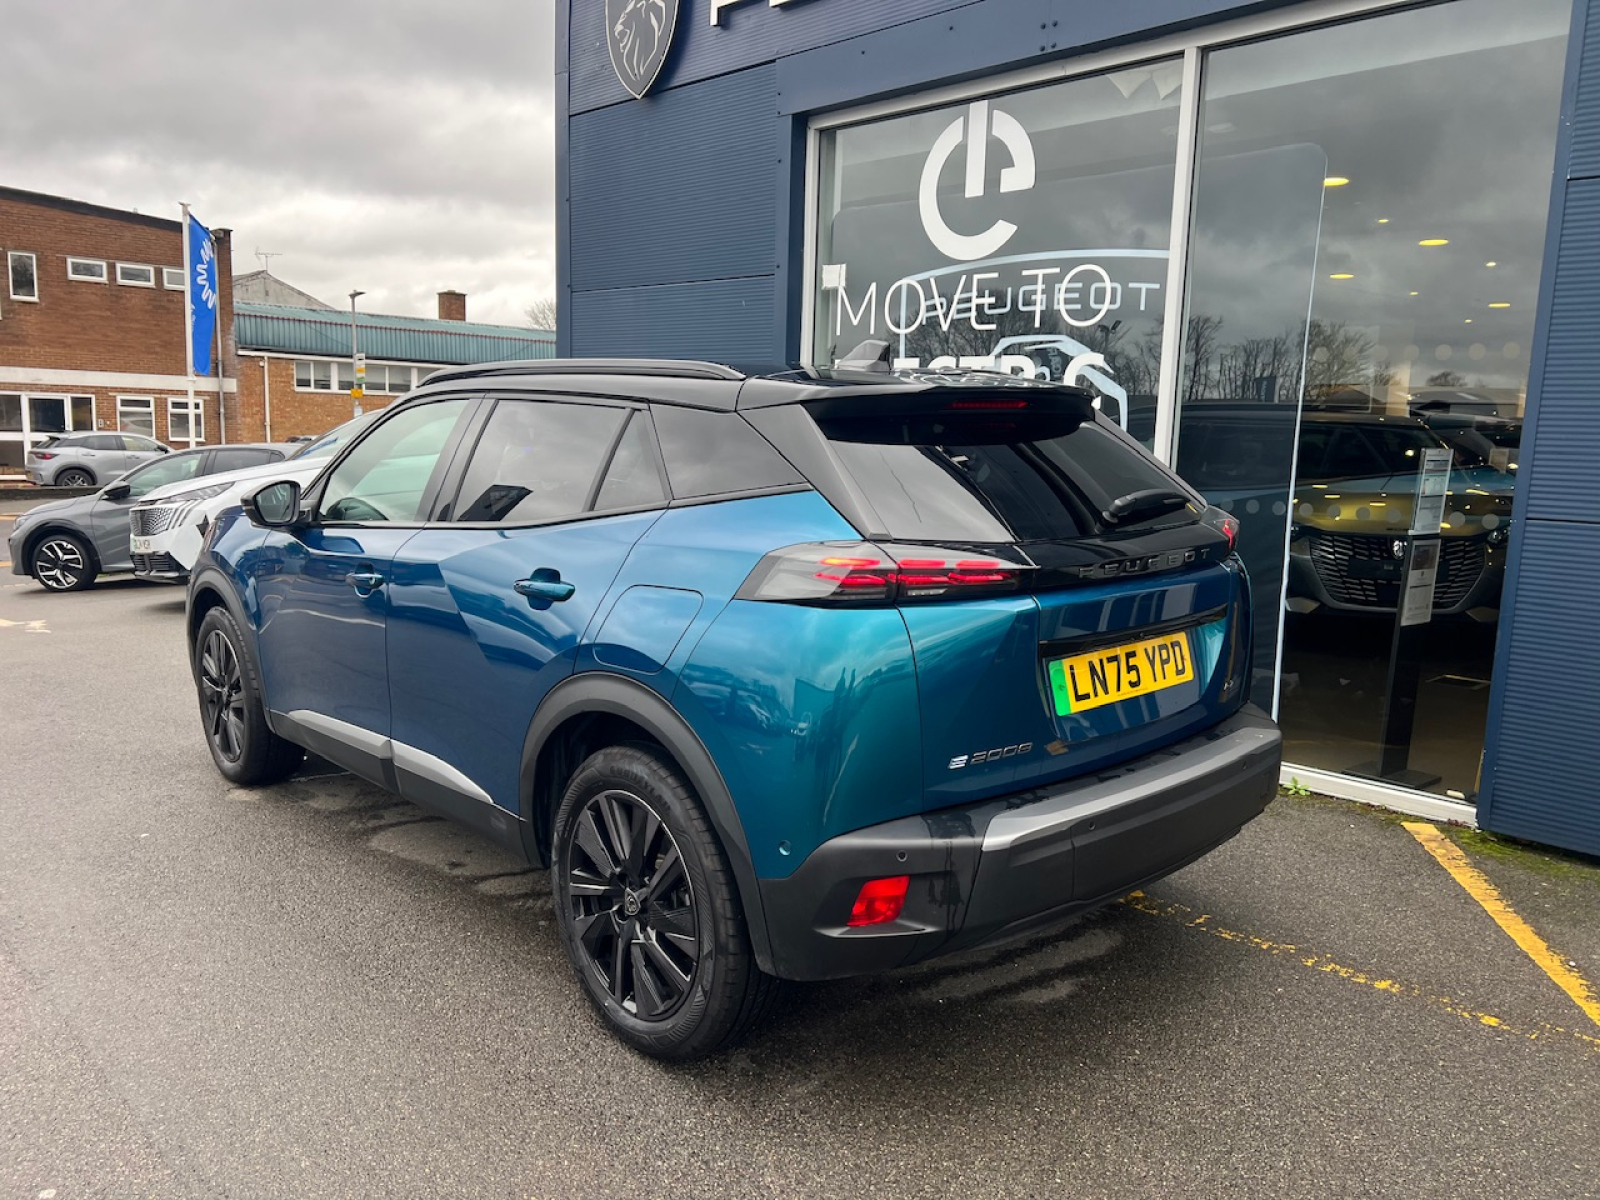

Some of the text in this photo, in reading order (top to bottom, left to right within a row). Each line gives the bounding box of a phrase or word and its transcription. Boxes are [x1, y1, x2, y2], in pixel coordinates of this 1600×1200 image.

[835, 264, 1112, 336] MOVE TO
[922, 281, 1161, 326] PEUGEOT
[1069, 639, 1186, 702] LN75 YPD
